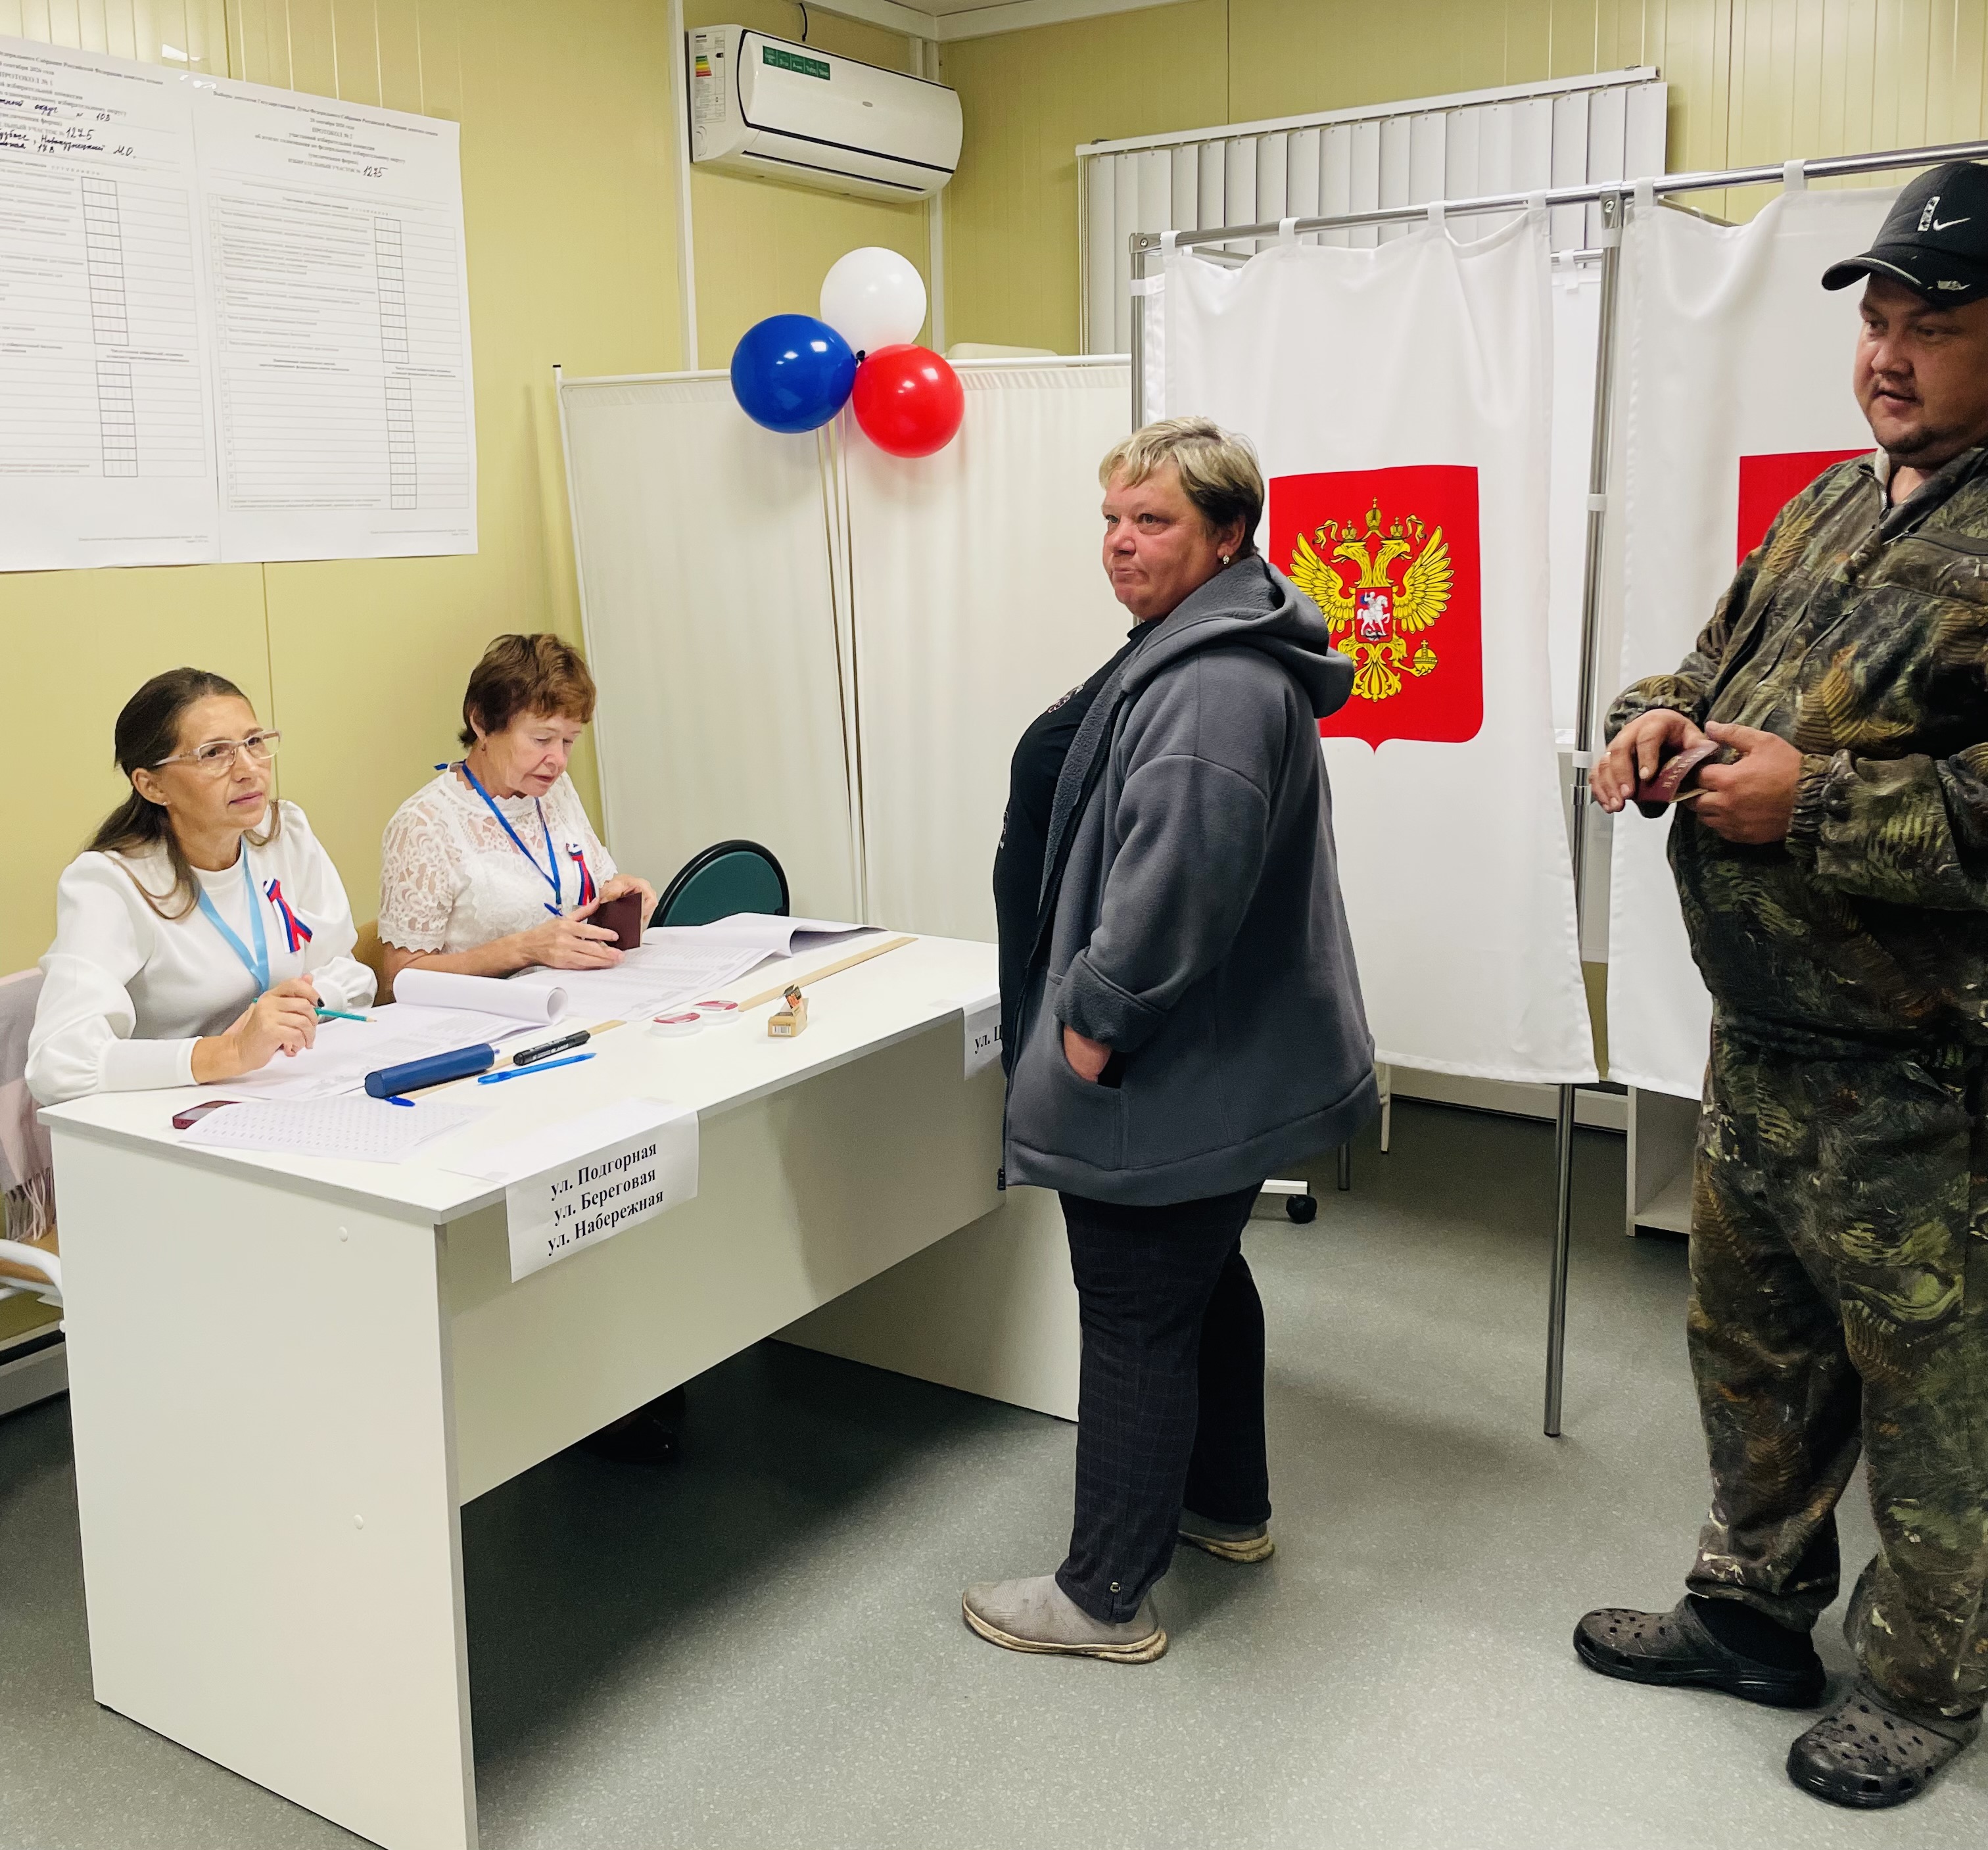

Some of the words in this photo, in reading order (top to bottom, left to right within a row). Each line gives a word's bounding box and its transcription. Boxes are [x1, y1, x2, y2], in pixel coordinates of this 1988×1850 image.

[66, 127, 95, 141] 1275
[974, 1034, 991, 1055] ул.
[994, 1024, 1003, 1041] Ц
[550, 1179, 573, 1202] ул.
[578, 1143, 657, 1185] Подгорная
[554, 1205, 577, 1227] ул.
[580, 1168, 656, 1211] Береговая
[547, 1234, 570, 1256] ул.
[575, 1191, 664, 1241] Набережная
